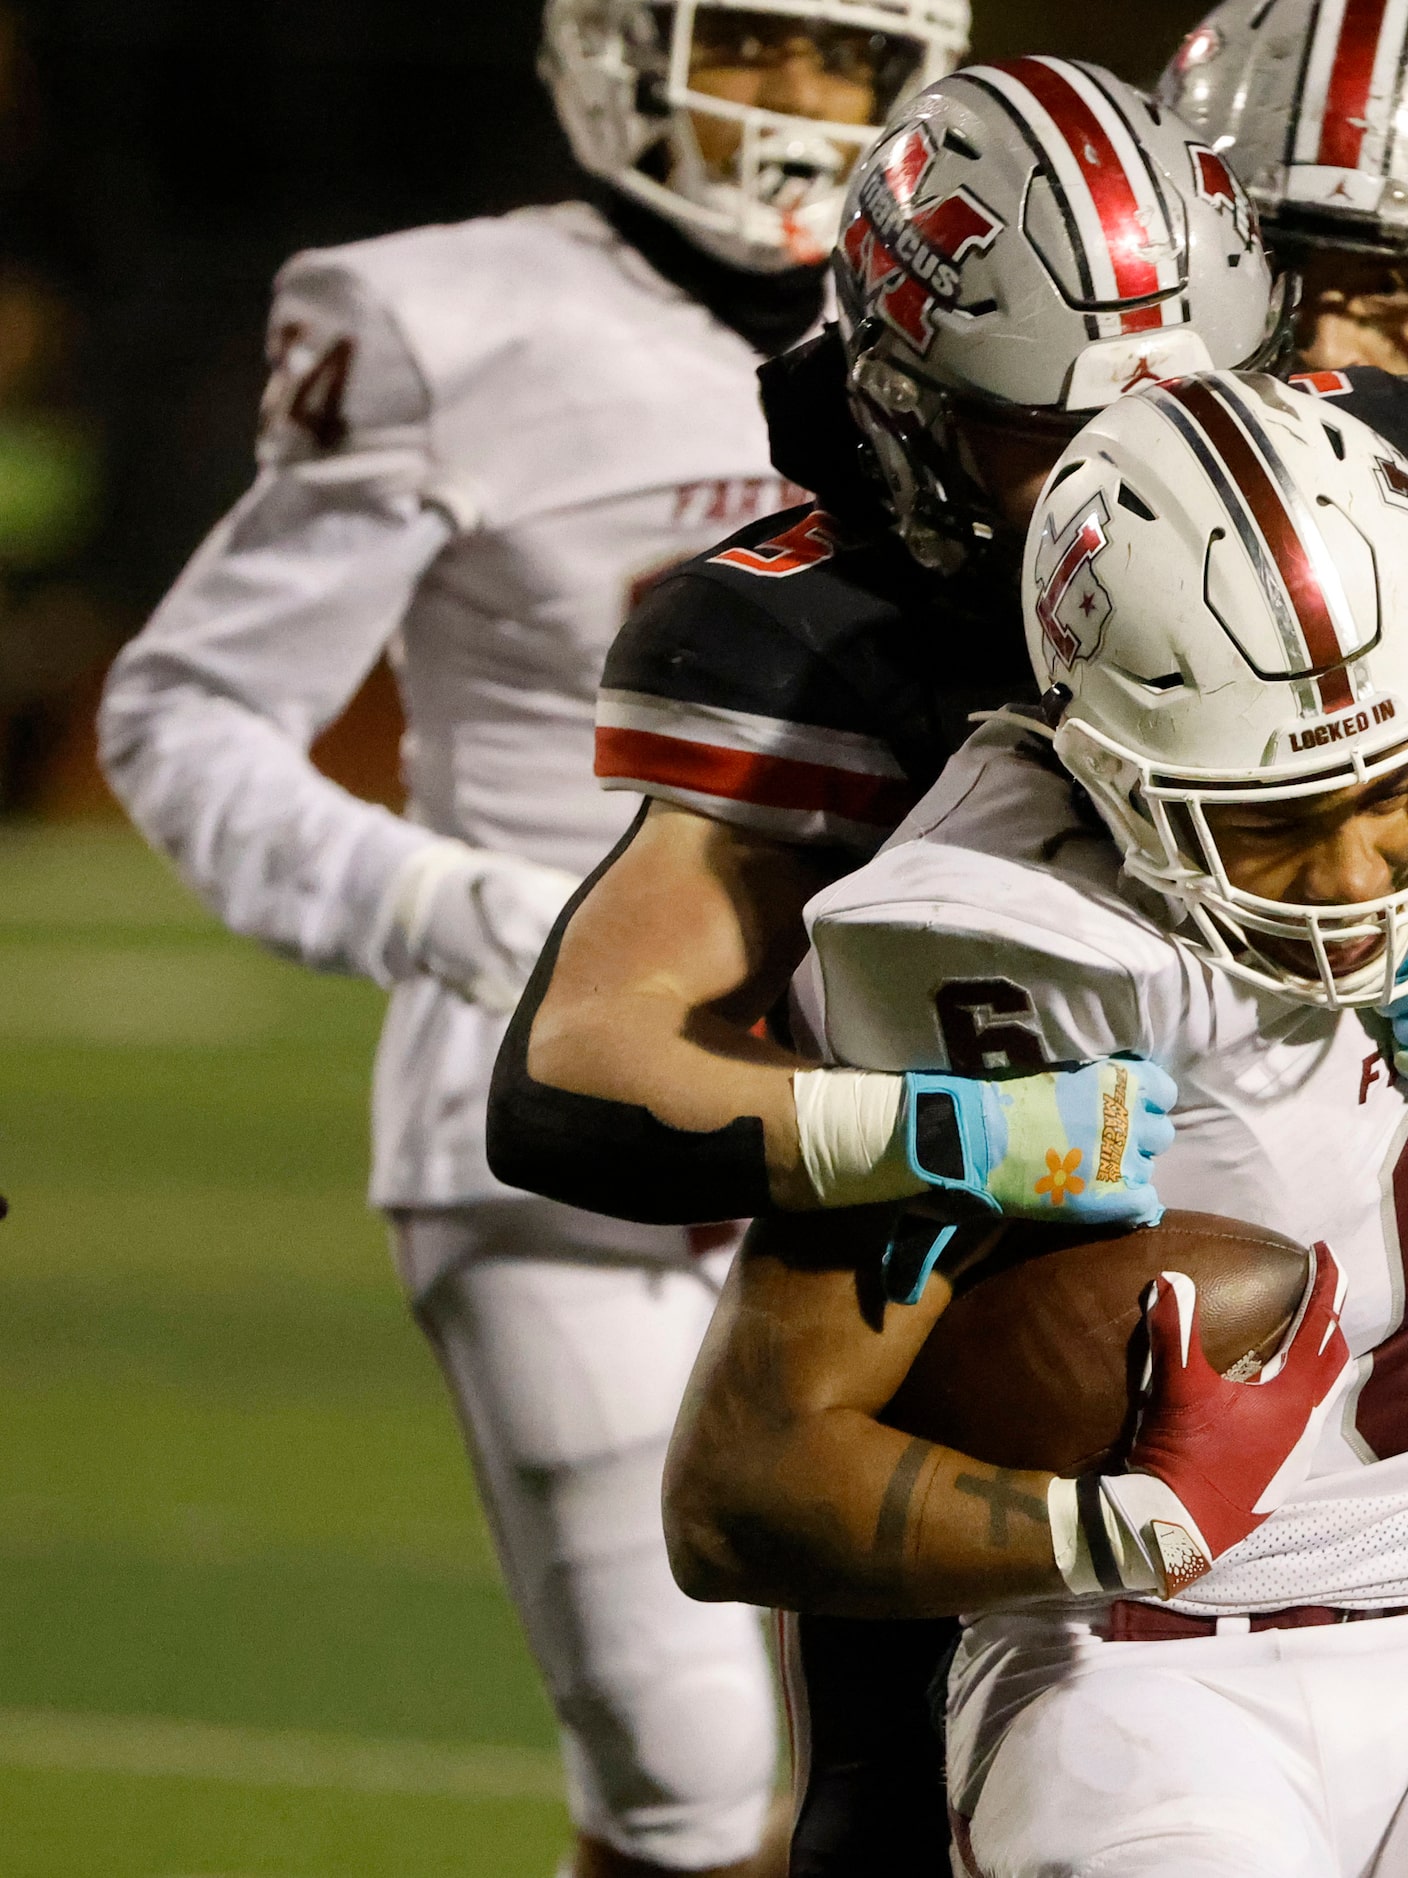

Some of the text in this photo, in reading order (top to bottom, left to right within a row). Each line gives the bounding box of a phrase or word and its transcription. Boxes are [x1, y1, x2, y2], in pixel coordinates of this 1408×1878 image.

[860, 163, 960, 298] marcus
[1289, 699, 1396, 752] LOCKED IN
